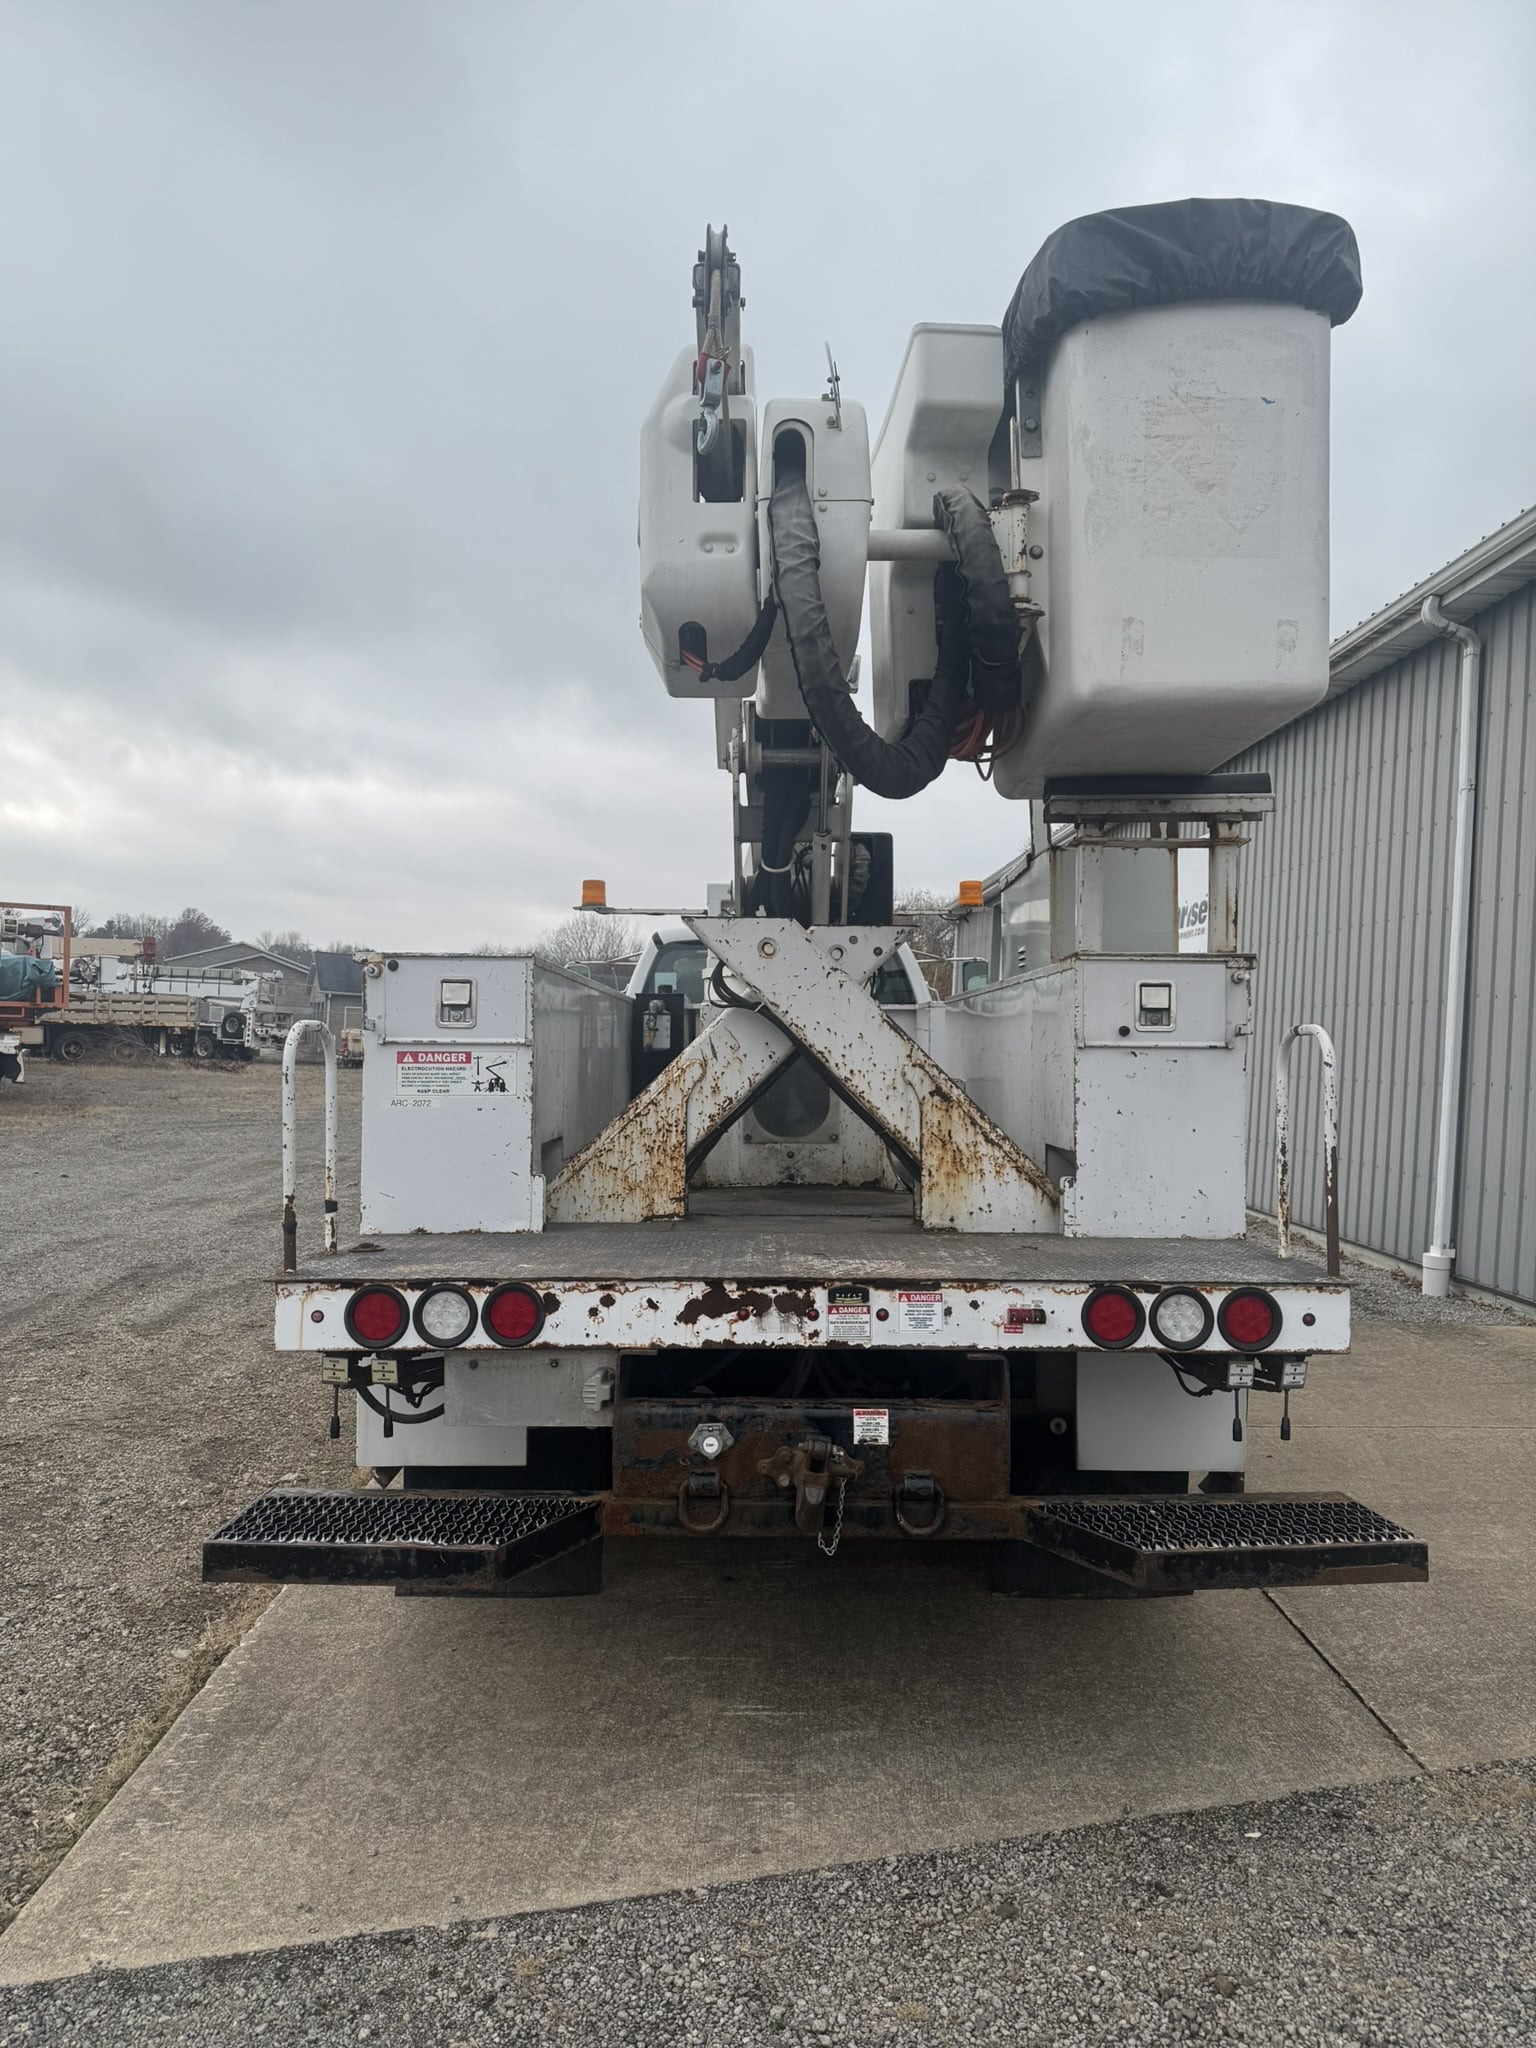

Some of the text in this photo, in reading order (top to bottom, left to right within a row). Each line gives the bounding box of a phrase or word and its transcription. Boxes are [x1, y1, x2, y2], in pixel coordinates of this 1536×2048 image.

[1178, 900, 1207, 929] rise
[418, 1053, 466, 1062] DANGER
[390, 1099, 432, 1107] ARC-2072
